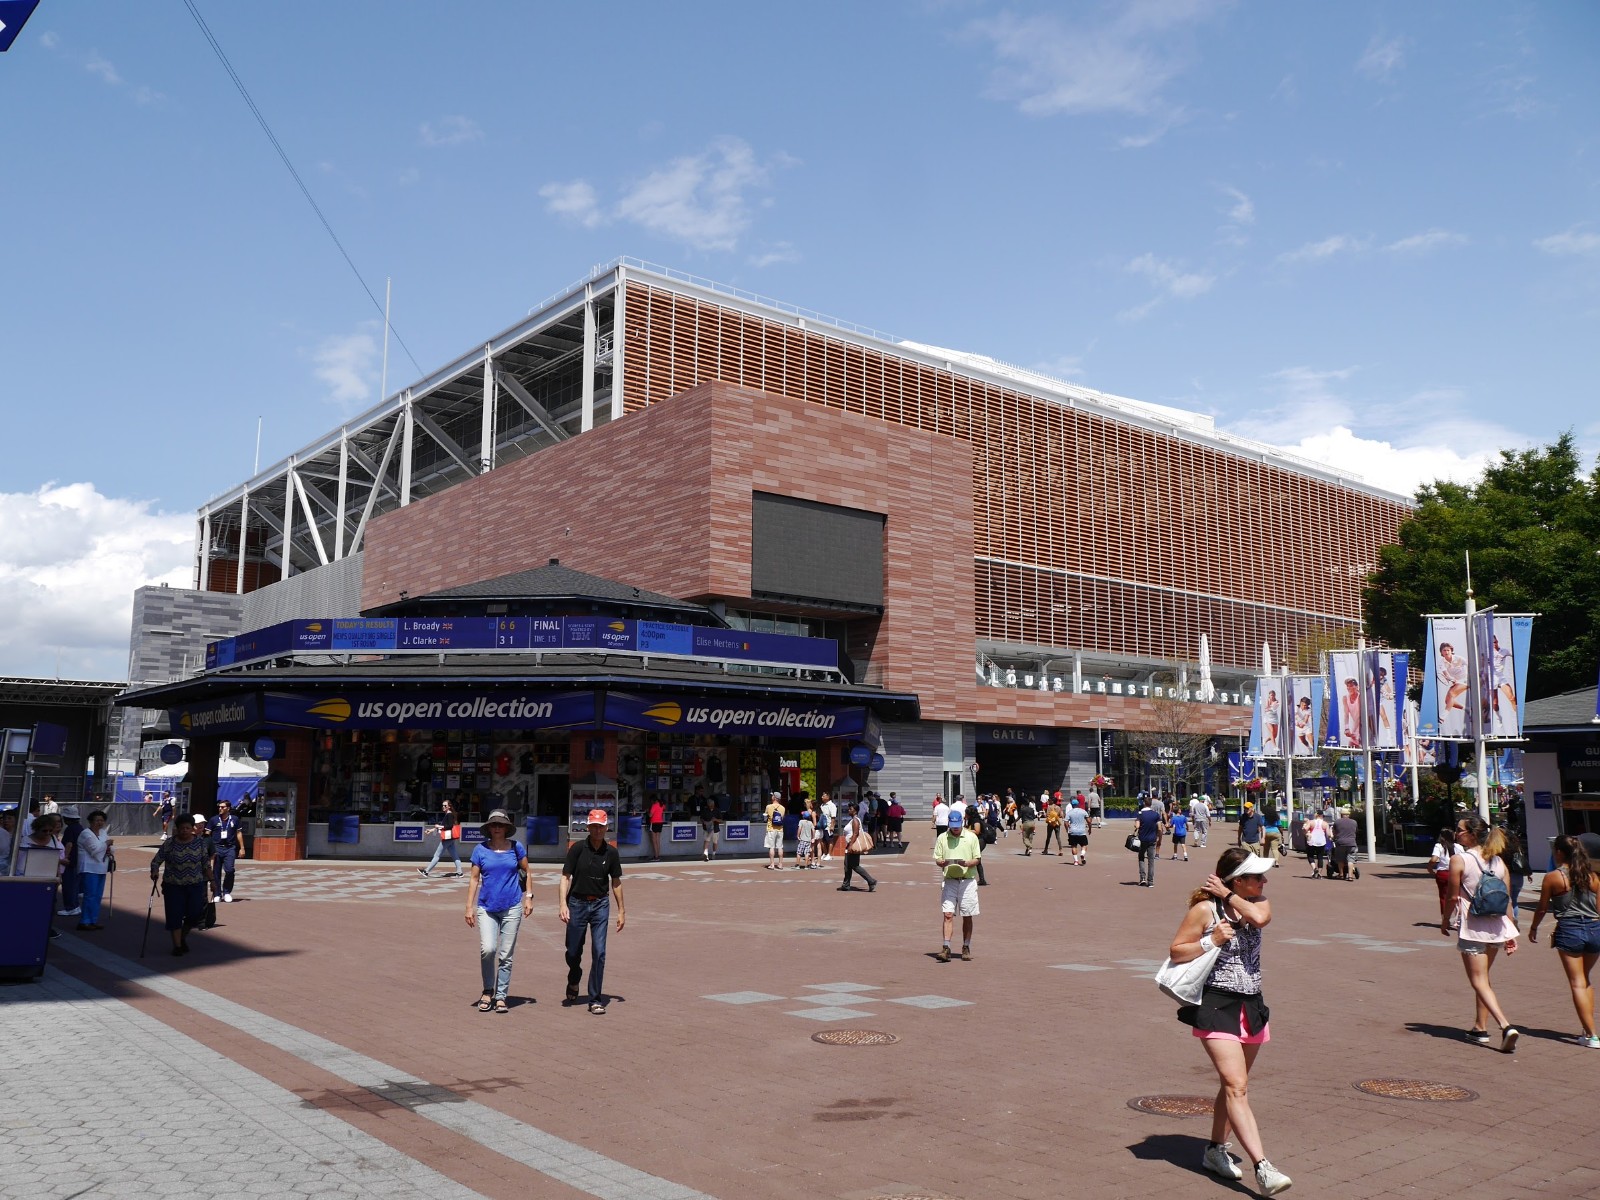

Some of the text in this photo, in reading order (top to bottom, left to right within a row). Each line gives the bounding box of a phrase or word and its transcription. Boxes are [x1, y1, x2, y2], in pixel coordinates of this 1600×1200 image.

[335, 620, 394, 629] TODAY'S RESULTS
[404, 622, 440, 631] L. Broady
[500, 620, 515, 630] 6 6
[534, 620, 560, 630] FINAL
[571, 631, 591, 641] IBM
[611, 633, 630, 642] open
[641, 629, 666, 640] 4:00pm
[403, 637, 437, 645] J. Clarke
[499, 636, 513, 645] 3 1
[640, 640, 649, 648] P3
[696, 637, 739, 649] Elise Mertens
[990, 672, 1063, 692] LOUIS
[1220, 692, 1252, 705] STA
[358, 697, 553, 723] us open collection
[191, 702, 246, 731] us open collection
[686, 707, 836, 729] us open collection
[992, 729, 1035, 741] GATE A
[1585, 747, 1600, 756] GU
